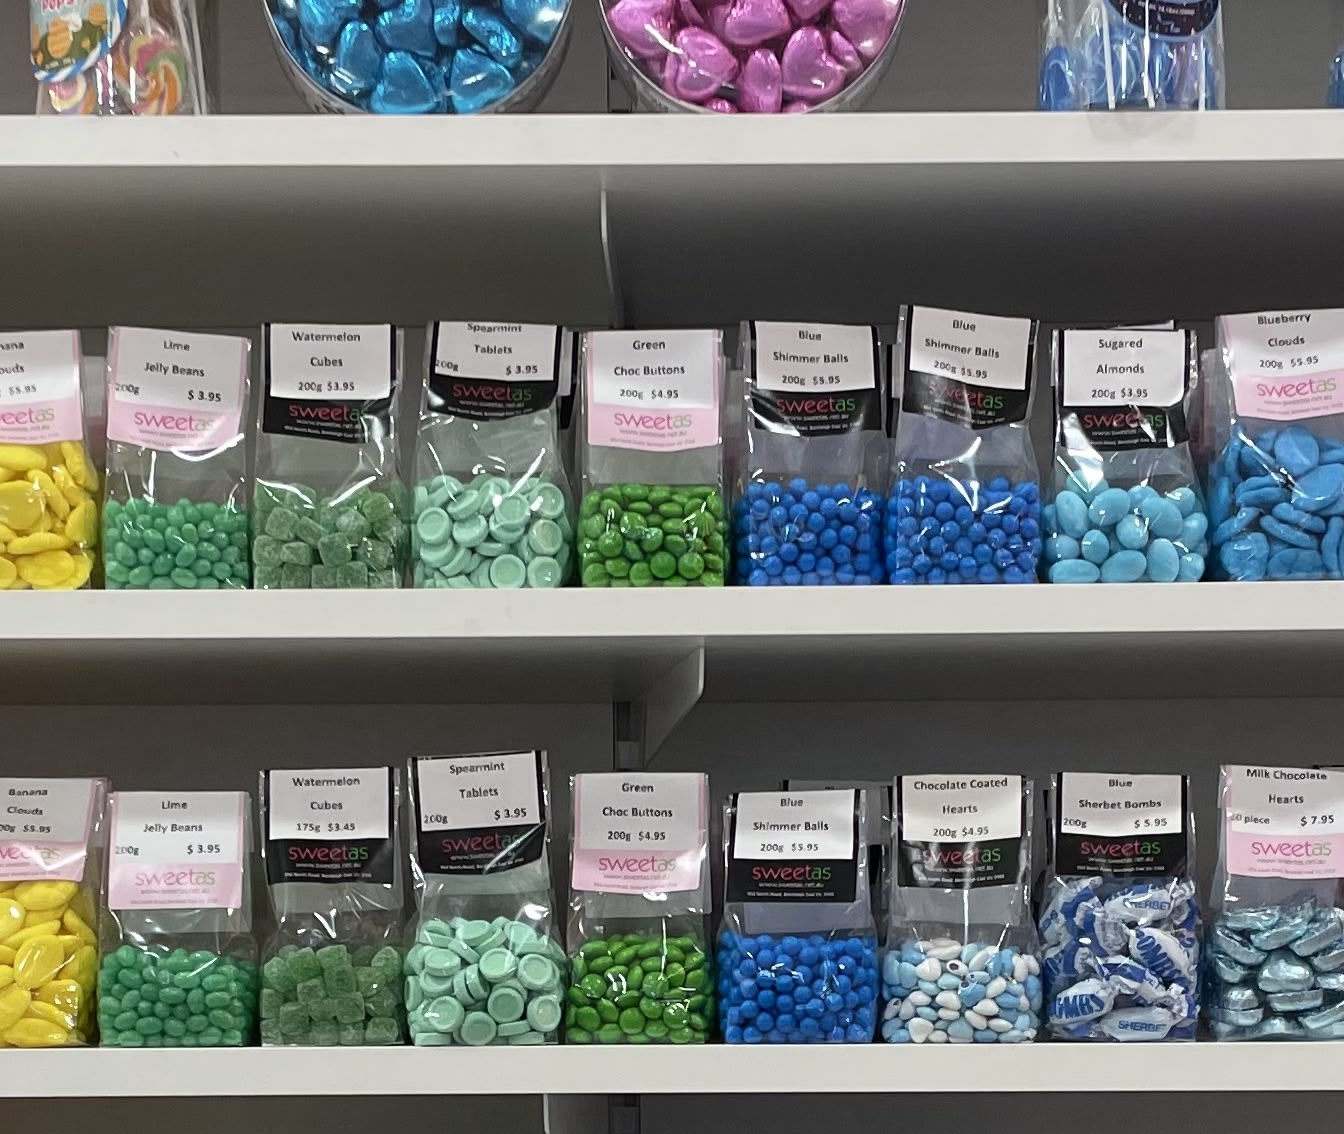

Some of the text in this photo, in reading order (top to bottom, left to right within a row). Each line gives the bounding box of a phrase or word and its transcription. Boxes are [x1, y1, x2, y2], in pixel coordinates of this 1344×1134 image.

[1257, 313, 1311, 326] Blueberry
[292, 331, 361, 343] Watermelon
[799, 330, 821, 340] Blue
[164, 341, 190, 352] Lime
[633, 339, 665, 351] Green
[1099, 338, 1142, 350] Sugared
[1268, 336, 1305, 347] Clouds
[474, 344, 513, 355] Tablets
[310, 356, 343, 367] Cubes
[773, 352, 848, 363] Shimmer Balls
[1259, 356, 1319, 369] 200g $5.95
[145, 363, 205, 378] Jelly Beans
[614, 364, 685, 376] Choc Buttons
[1096, 363, 1144, 374] Almonds
[782, 374, 840, 386] 200g $5.95
[298, 382, 355, 394] 200g $3.95
[453, 383, 532, 400] sweetas
[1091, 387, 1148, 399] 200g $3.95
[1257, 378, 1336, 397] sweetas
[620, 388, 678, 400] 200g $4.95
[614, 412, 692, 428] sweetas
[450, 761, 504, 775] Spearmint
[1247, 768, 1327, 780] Milk Chocolate
[621, 782, 654, 794] Green
[914, 778, 1008, 791] Chocolate Coated
[460, 787, 499, 798] Tablets
[1269, 793, 1304, 804] Hearts
[161, 800, 187, 810] Lime
[780, 797, 803, 807] Blue
[602, 807, 672, 818] Choc Buttons
[943, 803, 978, 815] Hearts
[143, 822, 202, 835] Jelly Beans
[753, 821, 828, 832] Shimmer Balls
[933, 826, 989, 838] 200g $4.95
[607, 830, 666, 842] 200g $4.95
[752, 864, 831, 880] sweetas
